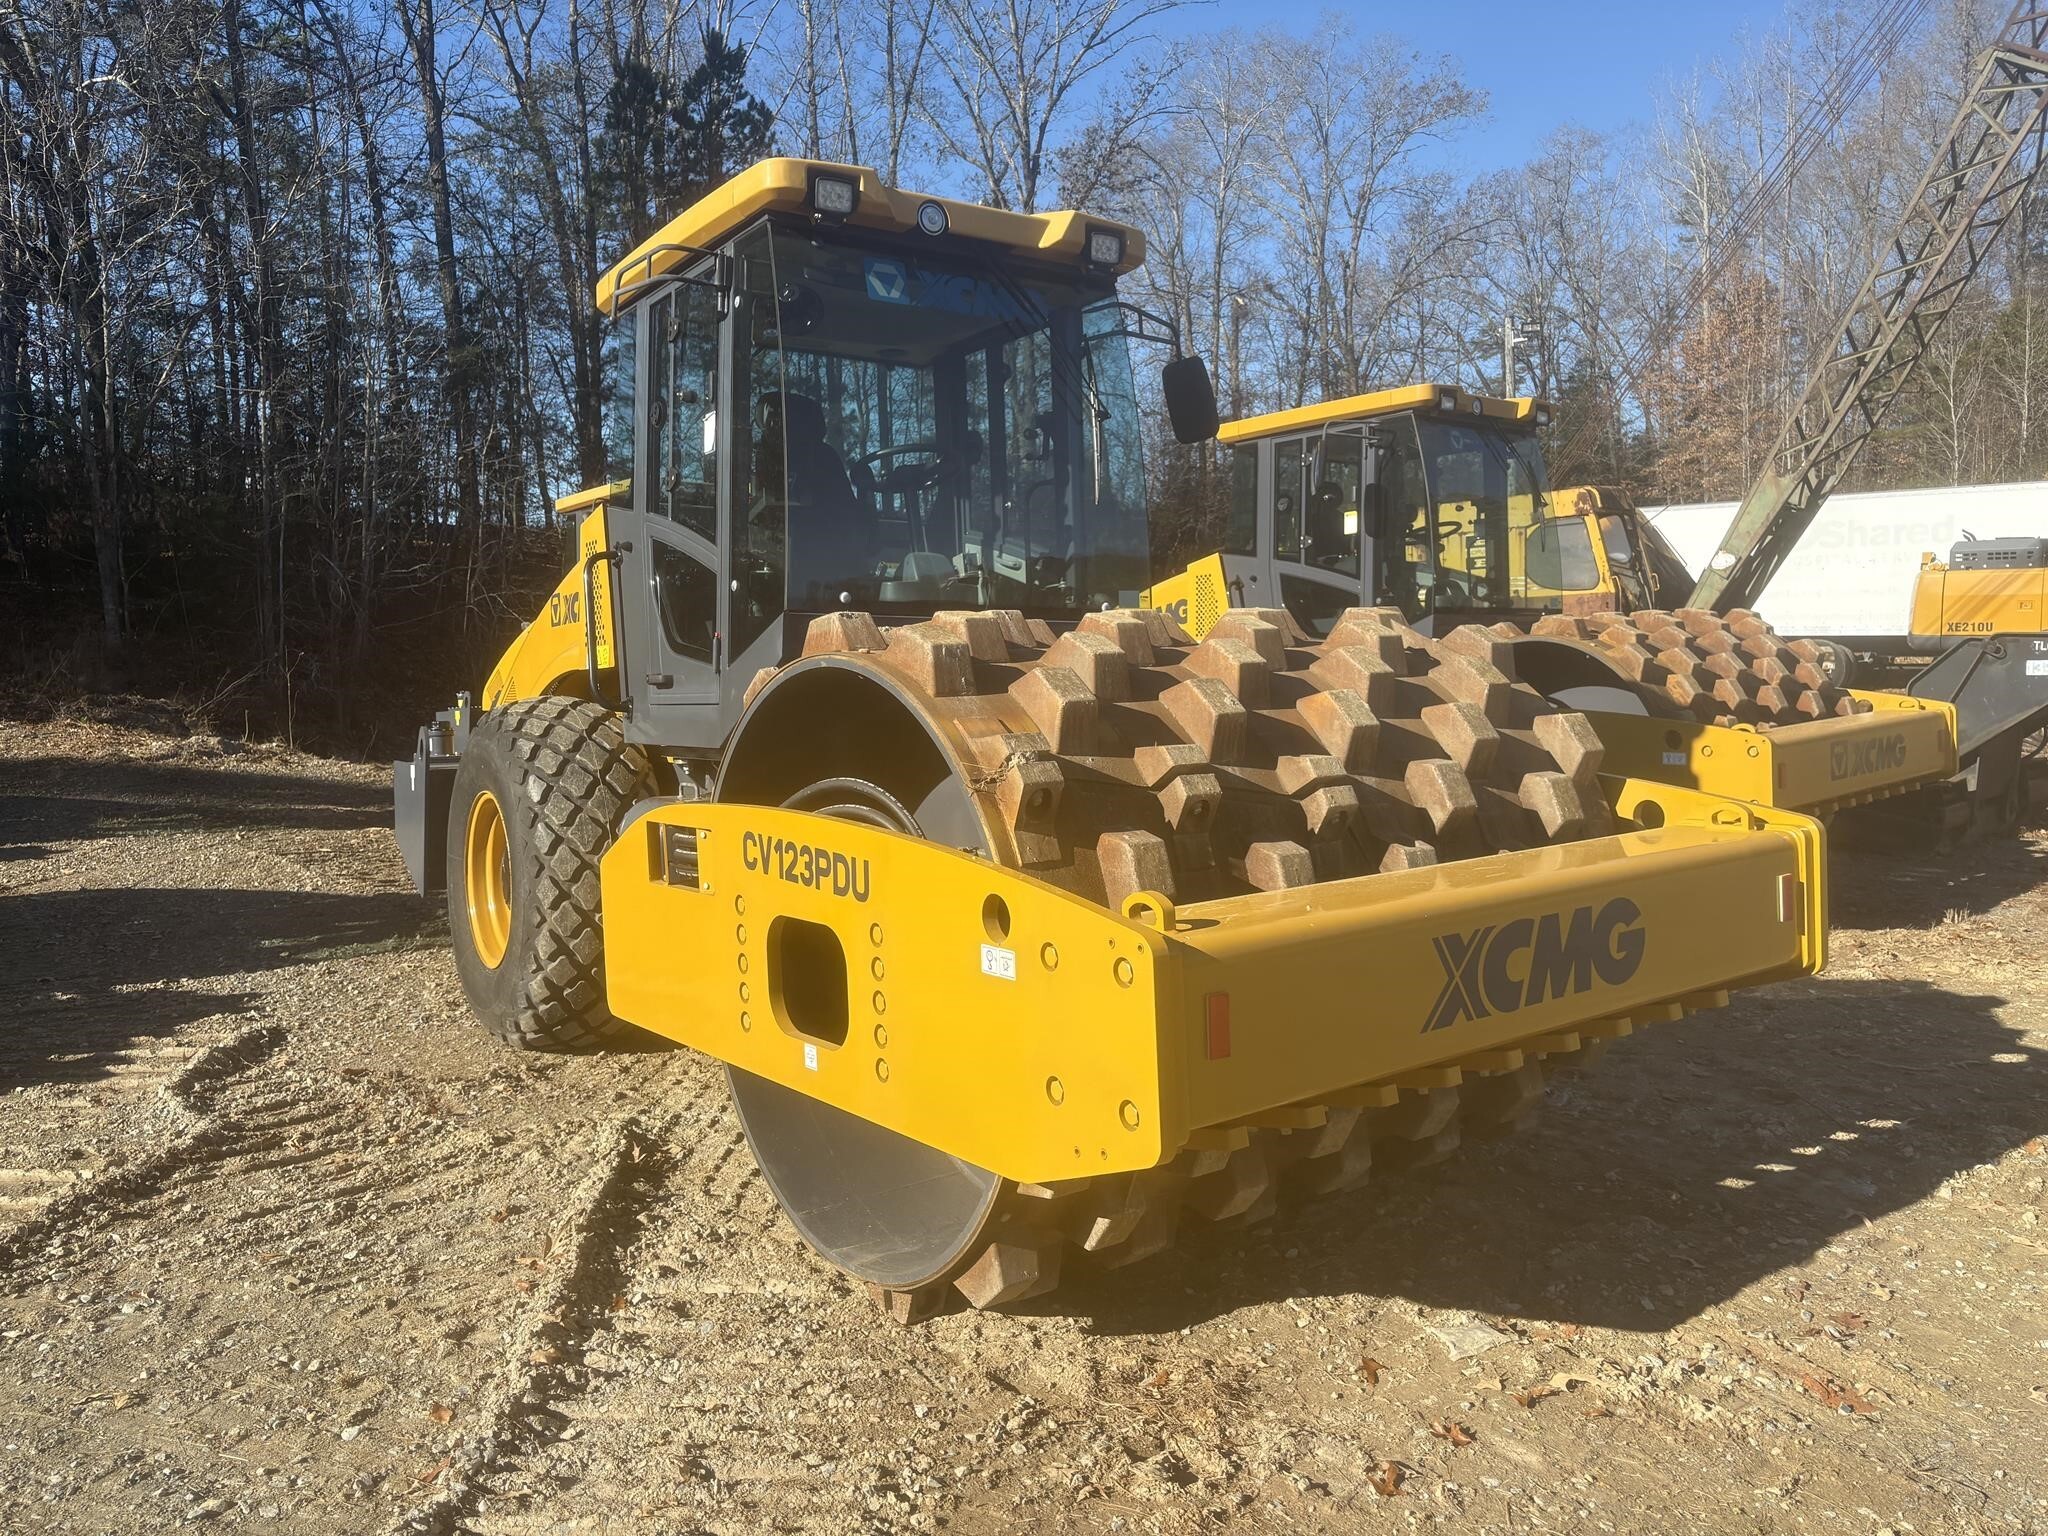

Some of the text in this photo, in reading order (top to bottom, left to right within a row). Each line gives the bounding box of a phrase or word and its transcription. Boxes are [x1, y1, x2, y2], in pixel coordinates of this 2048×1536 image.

[1819, 514, 1955, 549] Shared
[562, 592, 580, 625] XC
[1946, 622, 1994, 633] XE210U
[2033, 640, 2048, 651] TL
[1850, 733, 1907, 777] XCMG
[742, 830, 870, 903] CV123PDU
[1420, 897, 1646, 1034] XCMG
